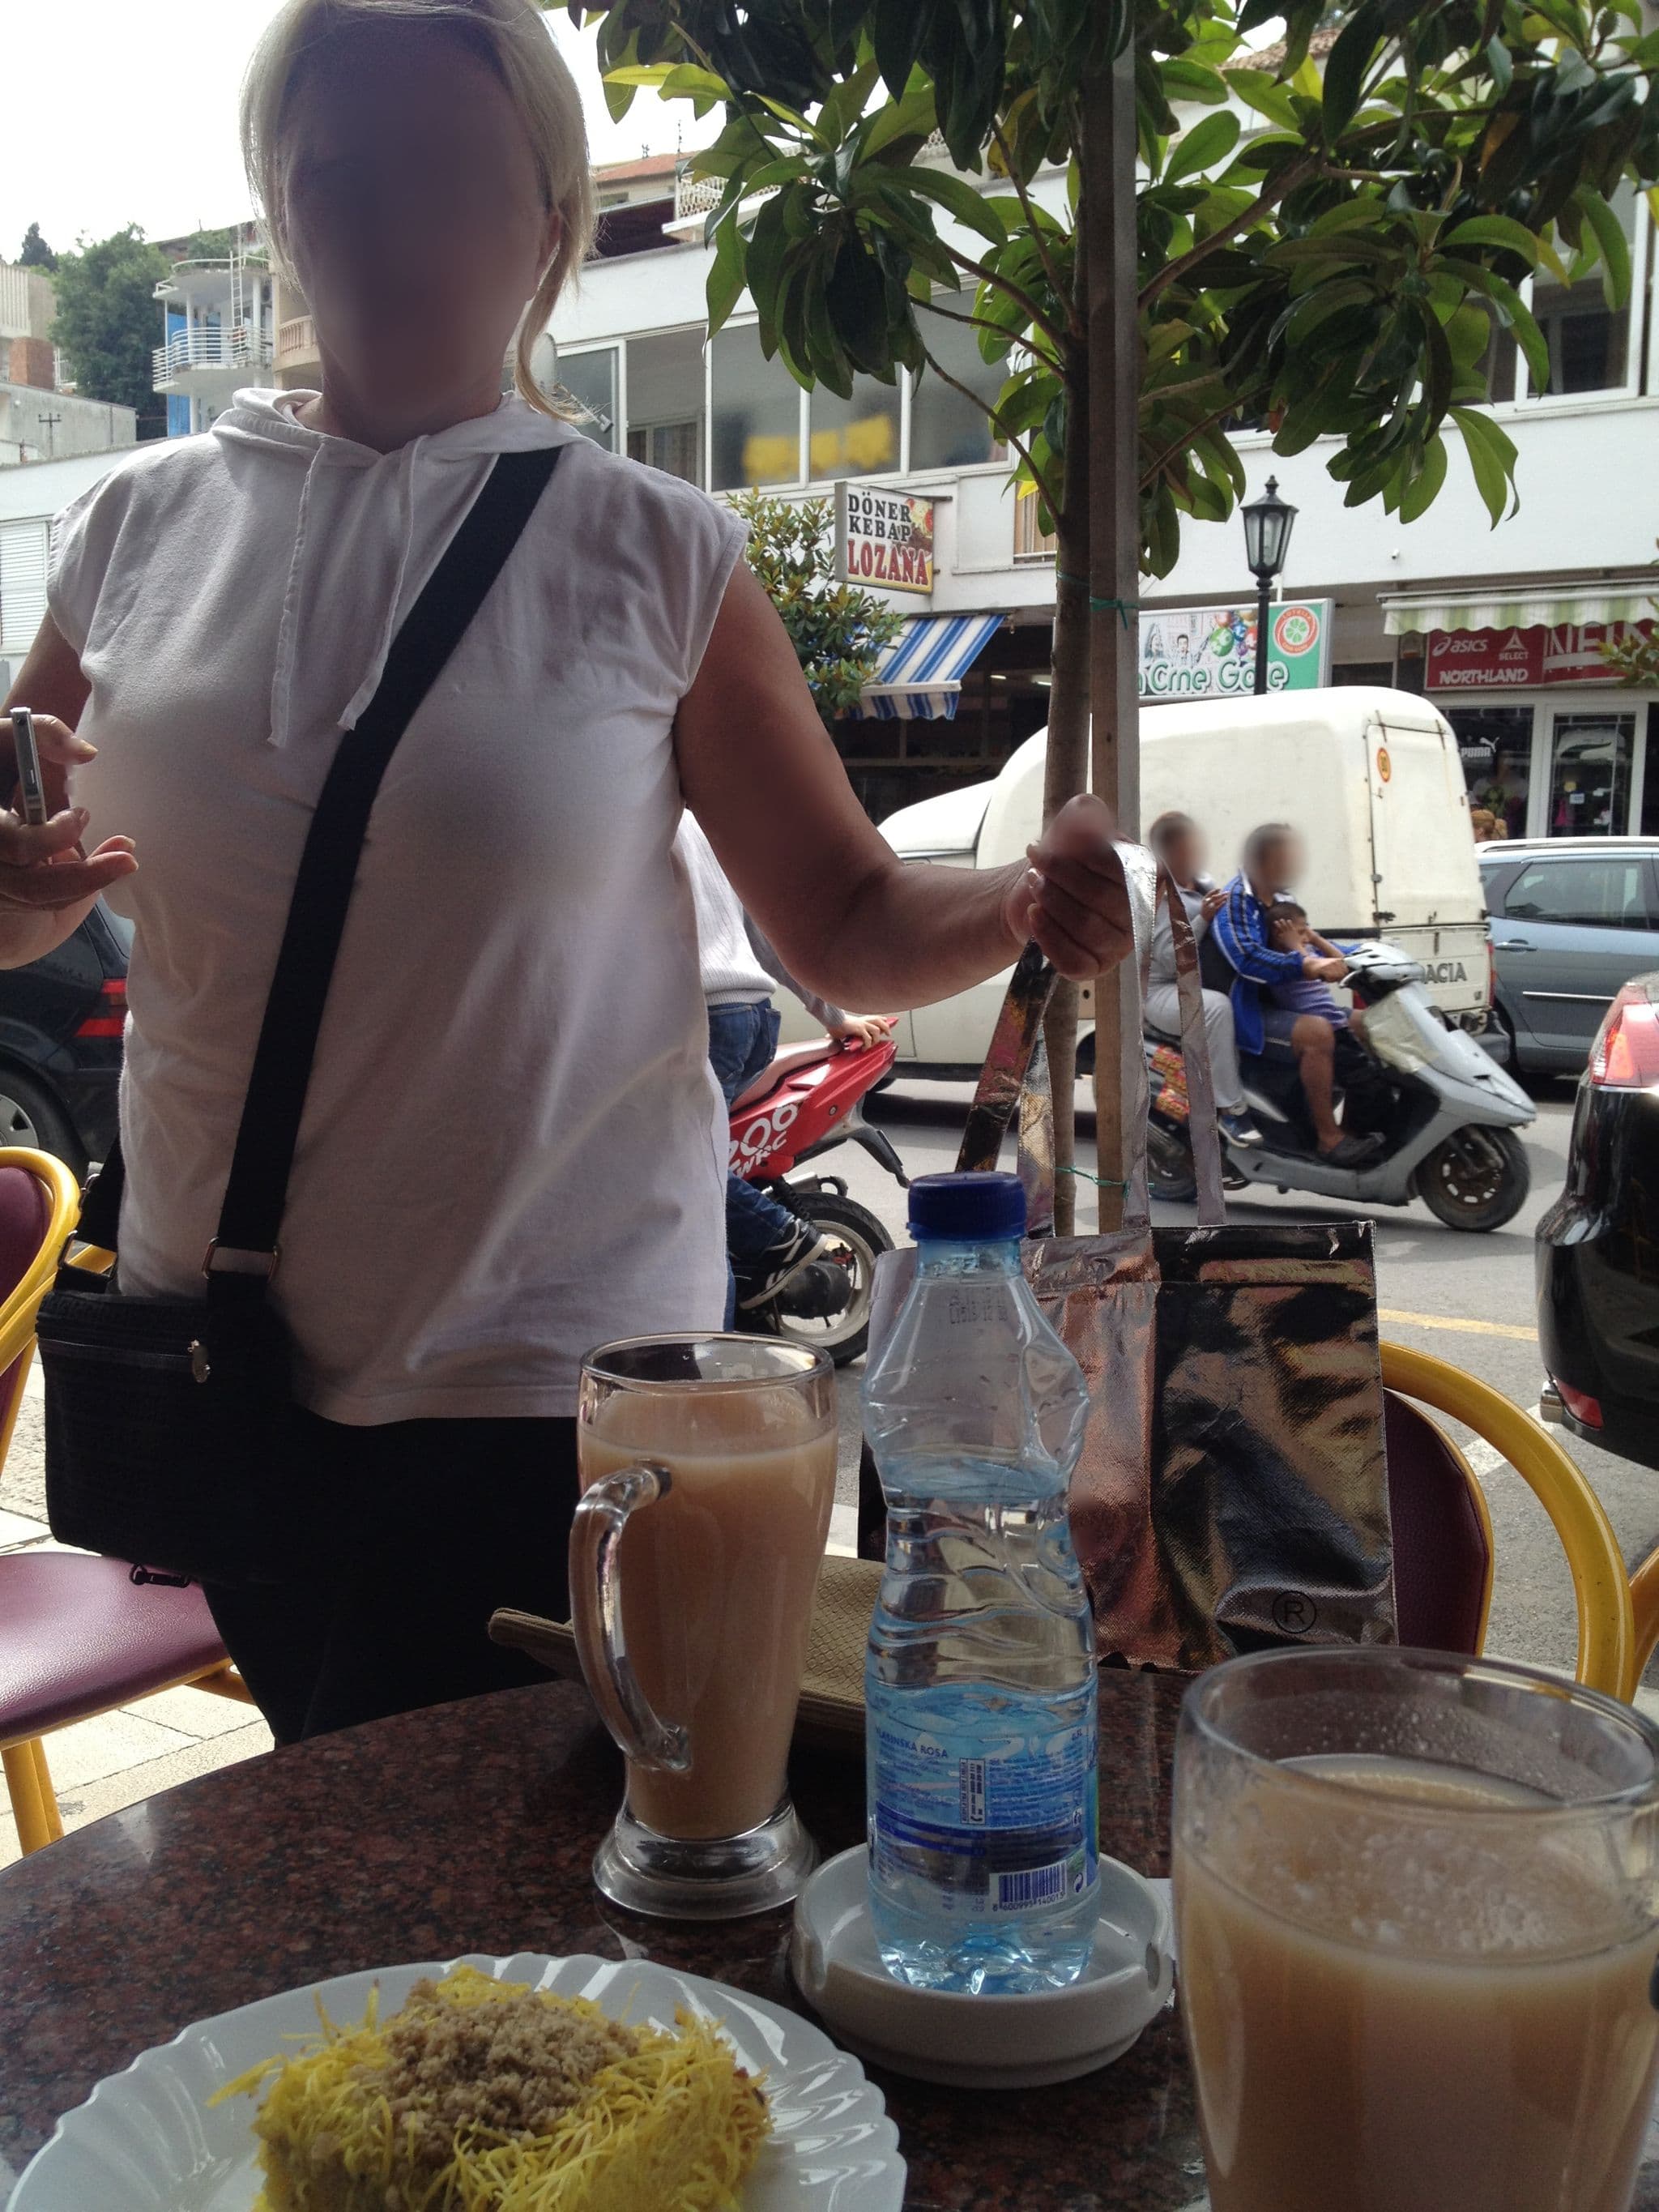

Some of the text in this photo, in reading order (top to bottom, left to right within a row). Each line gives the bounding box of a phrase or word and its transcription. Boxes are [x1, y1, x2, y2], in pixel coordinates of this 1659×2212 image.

[848, 491, 912, 523] DÖNER
[849, 515, 911, 542] KEBAP
[847, 538, 928, 586] LOZANA
[1499, 651, 1529, 661] SELECT
[1150, 660, 1209, 692] Crne
[1217, 659, 1288, 691] Goe
[1439, 668, 1529, 685] NORTHLAND
[1423, 962, 1467, 984] ACIA
[920, 1744, 948, 1758] ROSA
